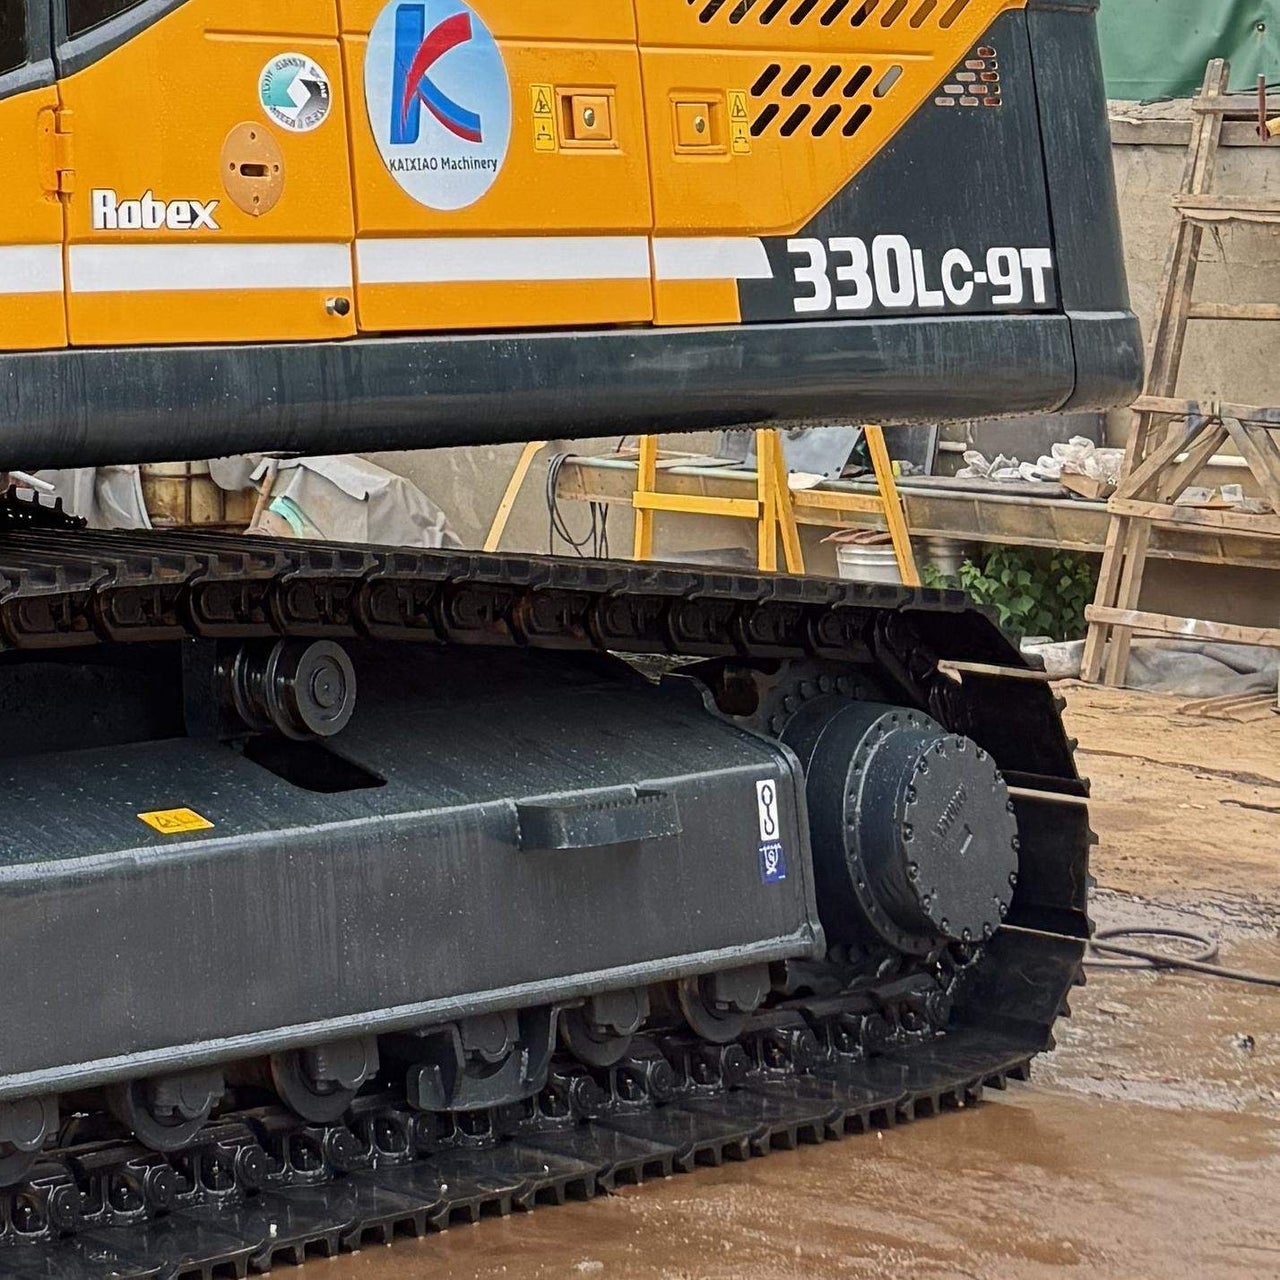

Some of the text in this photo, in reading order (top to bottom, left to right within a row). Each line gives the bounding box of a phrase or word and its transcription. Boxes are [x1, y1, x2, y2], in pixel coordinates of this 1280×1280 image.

[389, 155, 498, 173] KAIXIAO Machinery
[90, 188, 222, 230] Robex
[786, 234, 1053, 313] 330LC-9T
